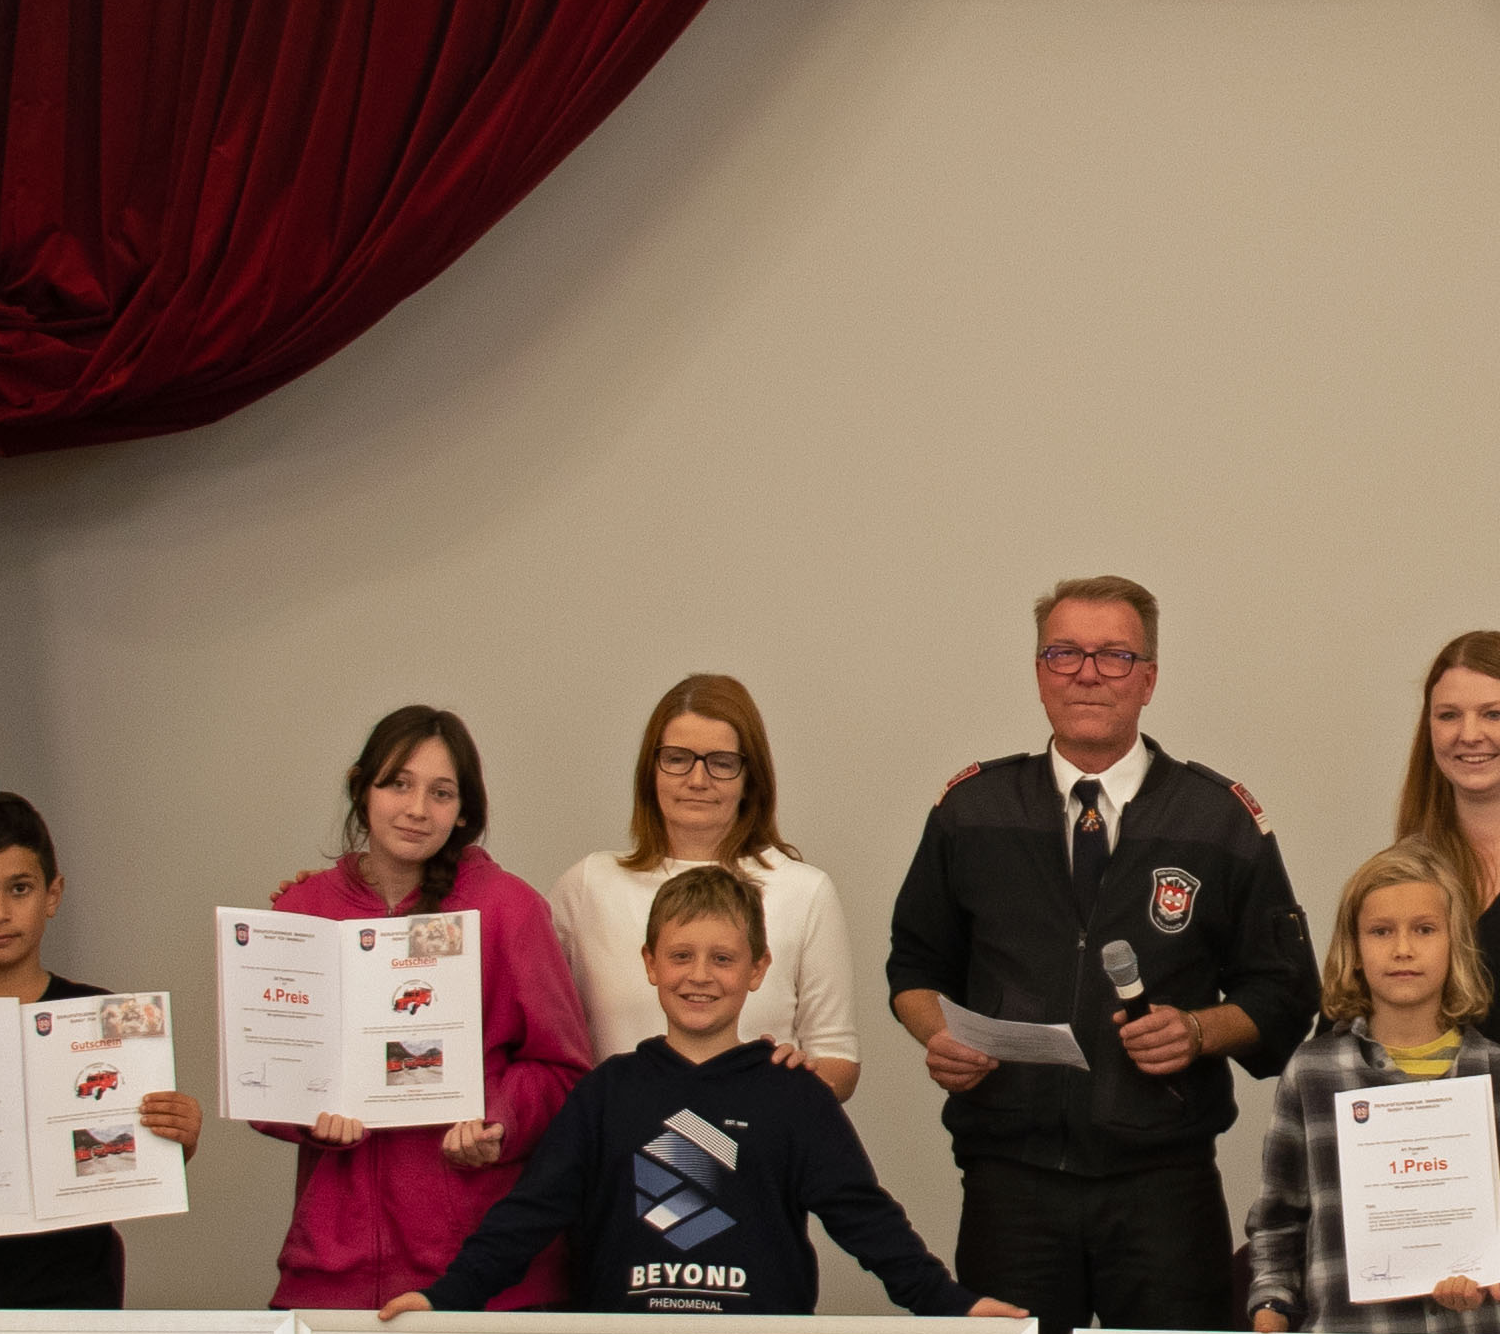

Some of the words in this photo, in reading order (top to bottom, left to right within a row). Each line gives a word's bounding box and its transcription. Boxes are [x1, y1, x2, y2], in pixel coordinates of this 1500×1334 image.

[263, 988, 310, 1005] 4.Preis
[1389, 1157, 1448, 1174] 1.Preis
[632, 1263, 747, 1287] BEYOND
[649, 1297, 723, 1311] PHENOMENAL
